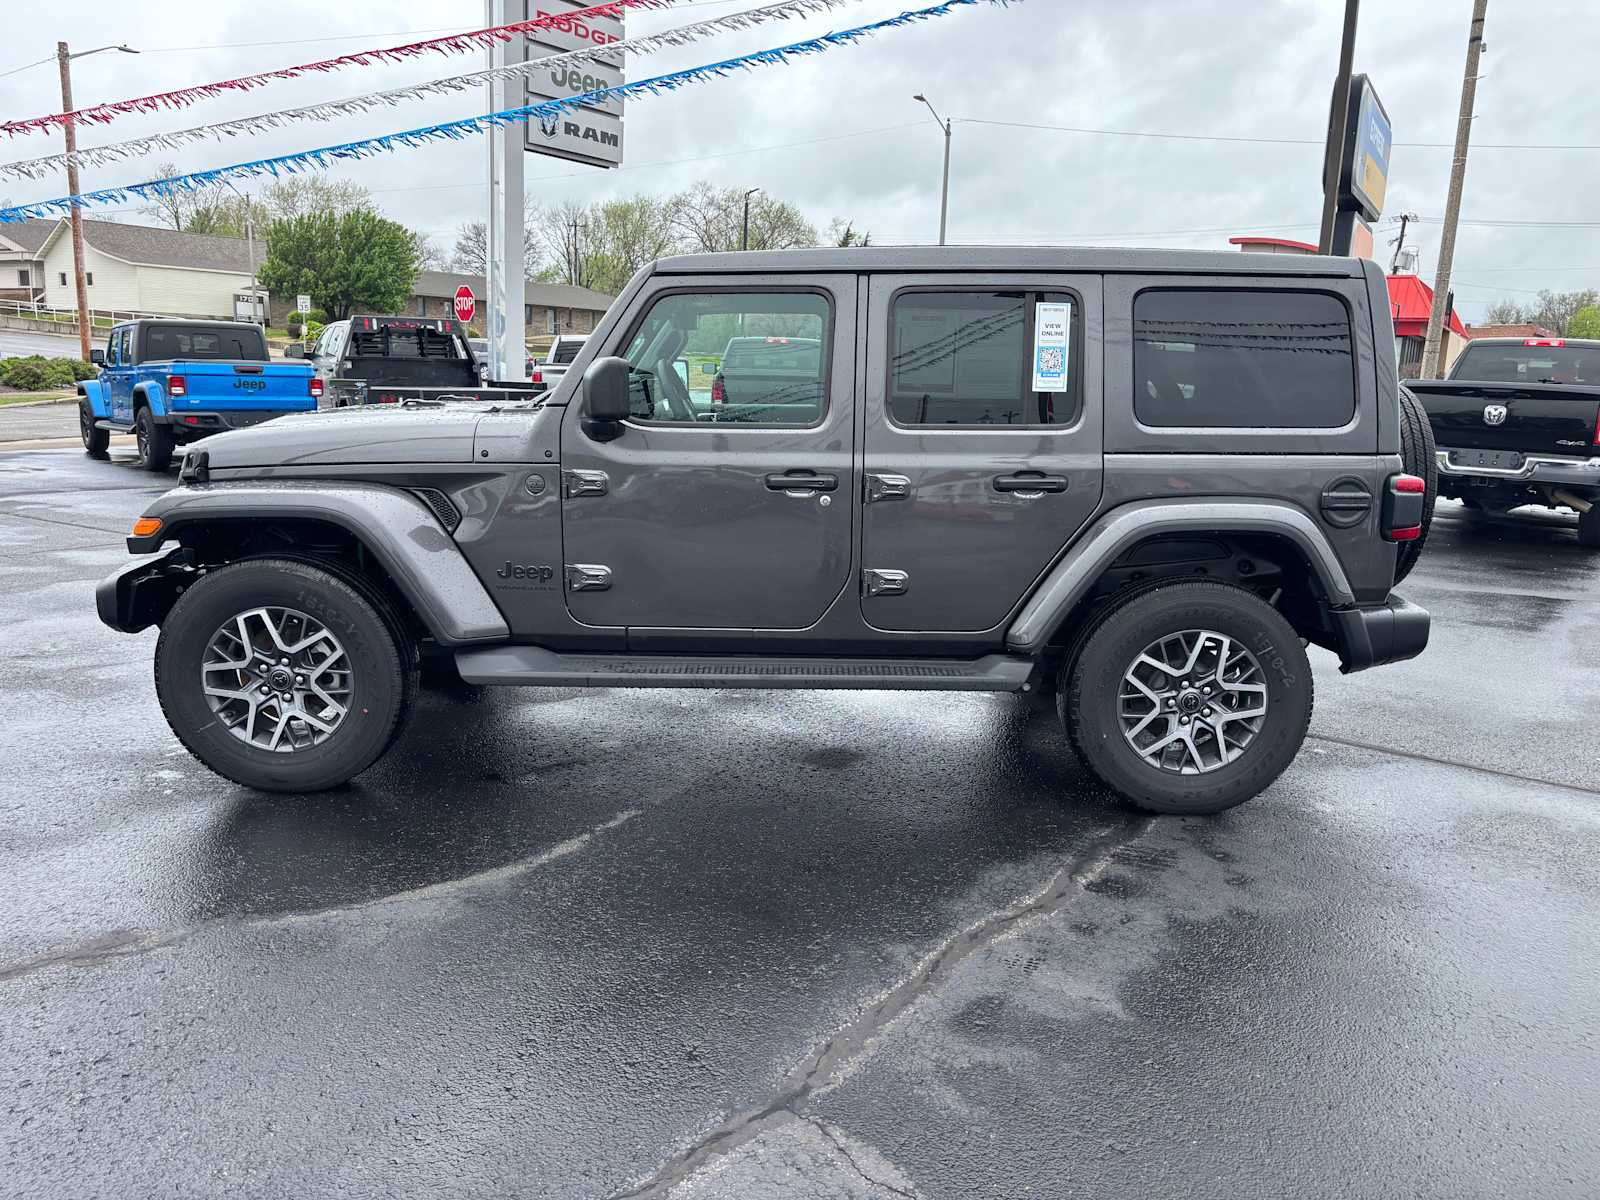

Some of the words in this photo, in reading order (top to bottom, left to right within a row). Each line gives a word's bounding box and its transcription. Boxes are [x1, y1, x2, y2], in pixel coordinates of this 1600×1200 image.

[564, 121, 618, 147] RAM
[455, 296, 473, 311] STOP
[233, 378, 266, 391] Jeep
[496, 560, 554, 583] Jeep
